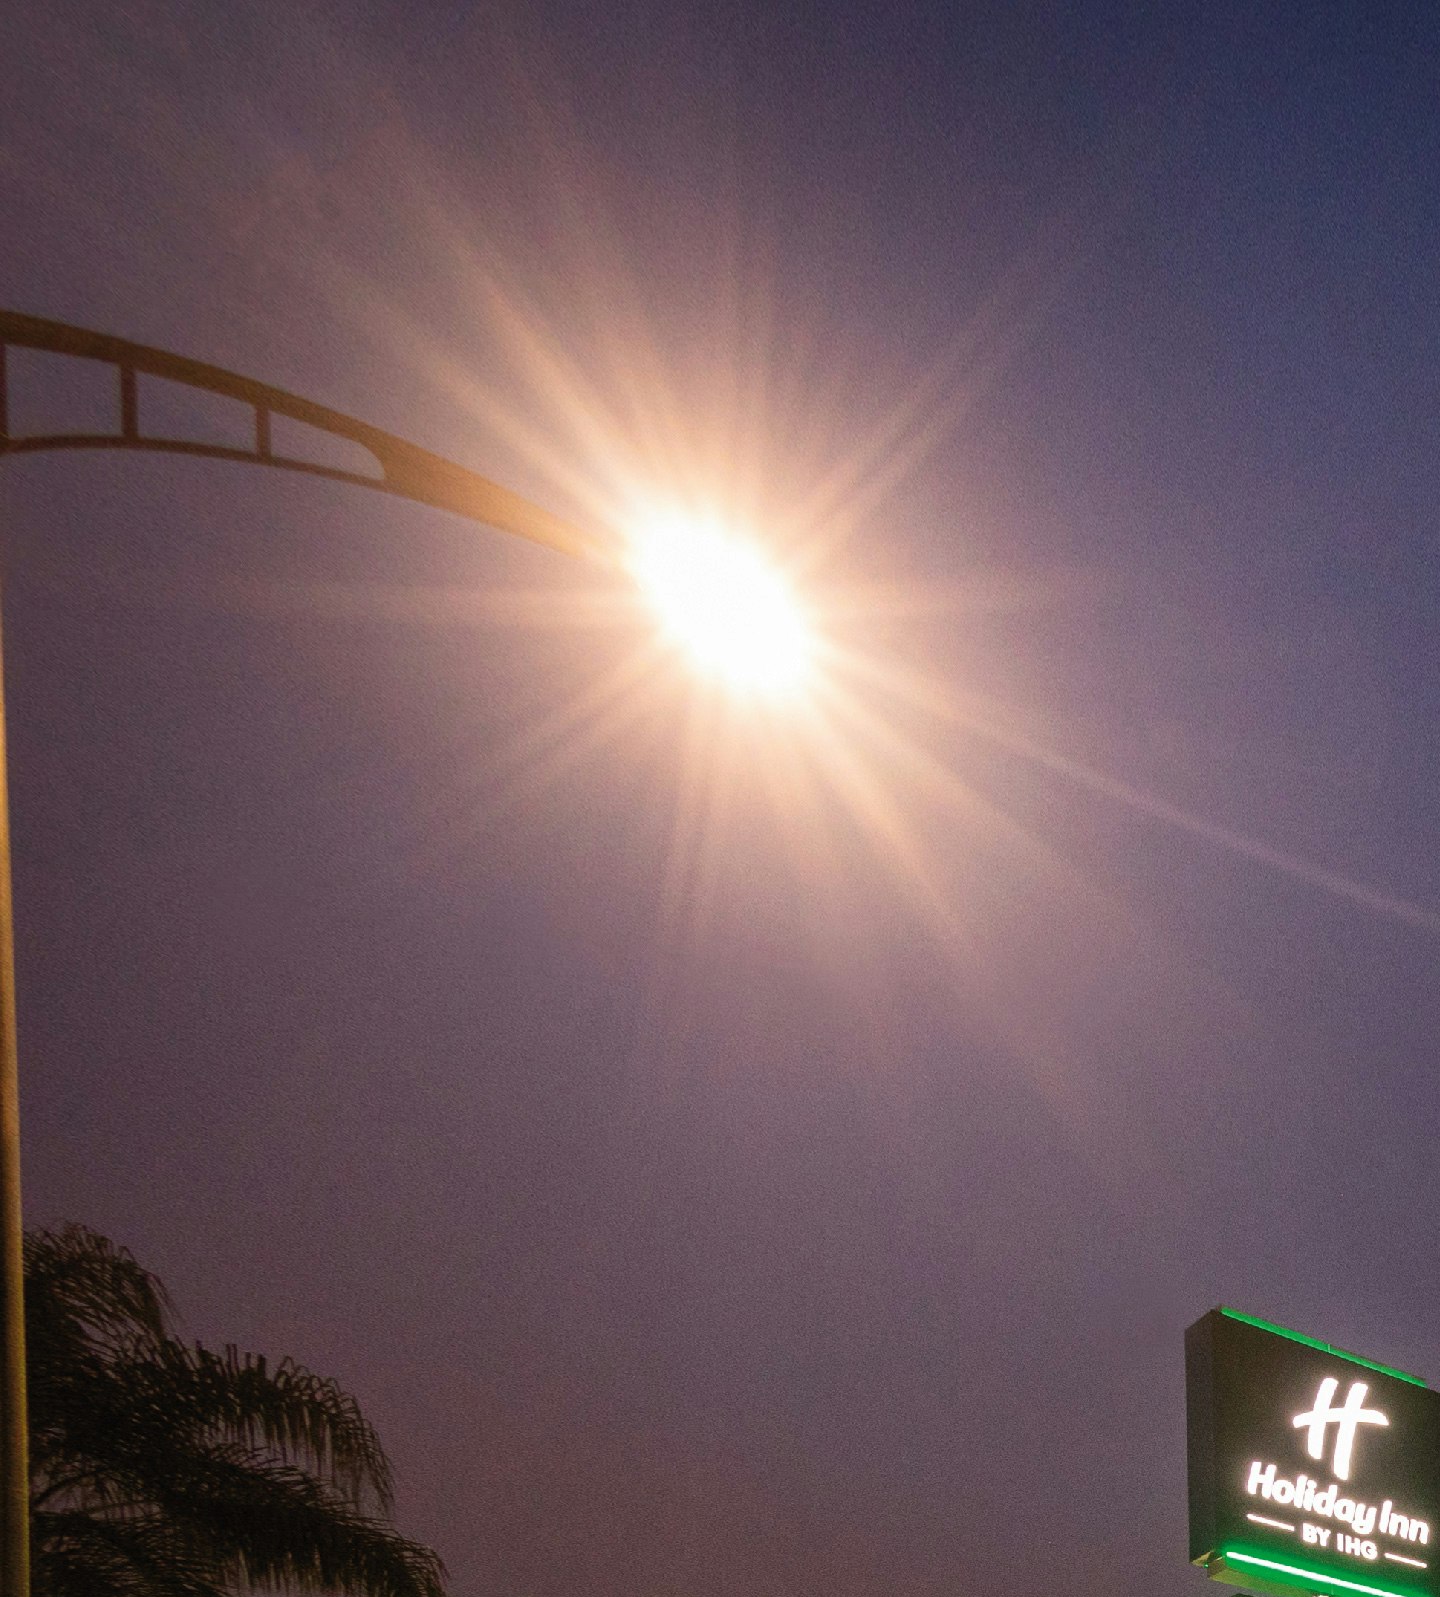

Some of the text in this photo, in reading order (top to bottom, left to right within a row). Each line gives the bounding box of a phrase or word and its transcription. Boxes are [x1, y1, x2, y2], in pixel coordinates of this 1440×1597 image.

[1247, 1461, 1430, 1544] Holiday Inn
[1302, 1524, 1379, 1560] BY IHG
